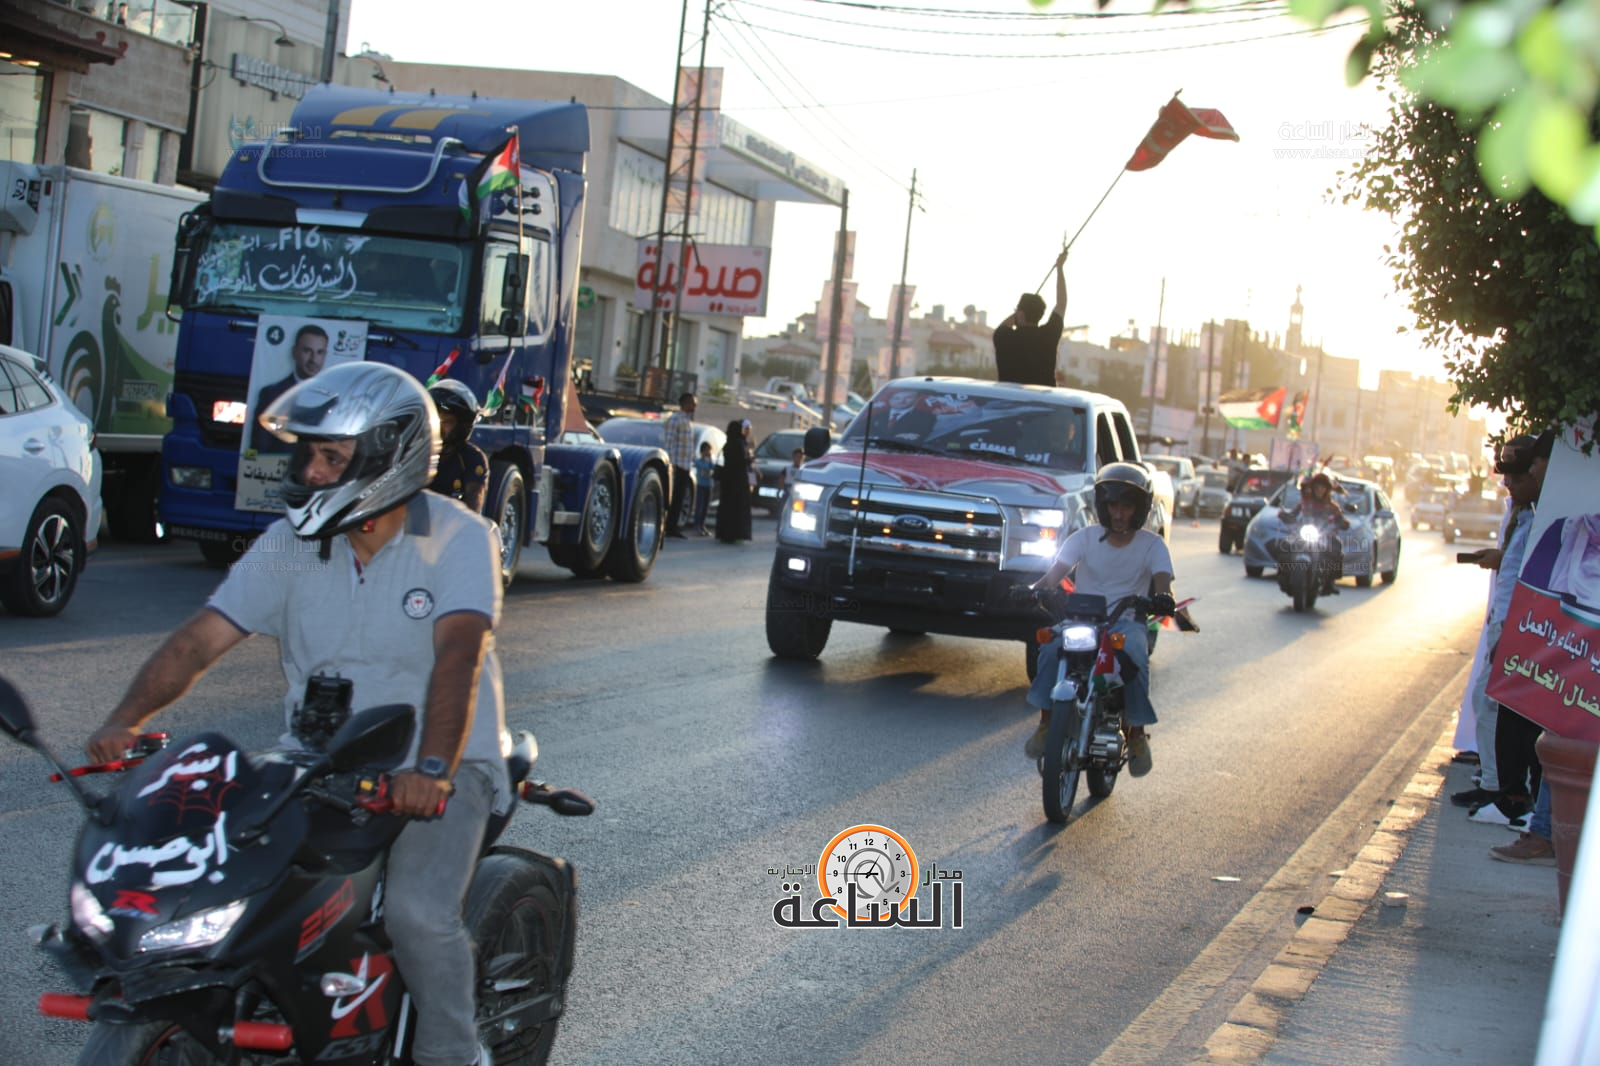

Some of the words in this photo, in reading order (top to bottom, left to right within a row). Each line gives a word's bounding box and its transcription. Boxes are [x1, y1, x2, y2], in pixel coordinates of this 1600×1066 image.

[279, 226, 320, 250] F16
[637, 243, 763, 313] صيدلية
[270, 329, 280, 342] 4
[171, 526, 228, 541] MERCEDES
[1518, 610, 1558, 648] والعمل
[1556, 630, 1589, 660] البناء
[1503, 654, 1566, 694] الخالدي
[1563, 683, 1600, 718] ضال
[297, 877, 355, 949] 250
